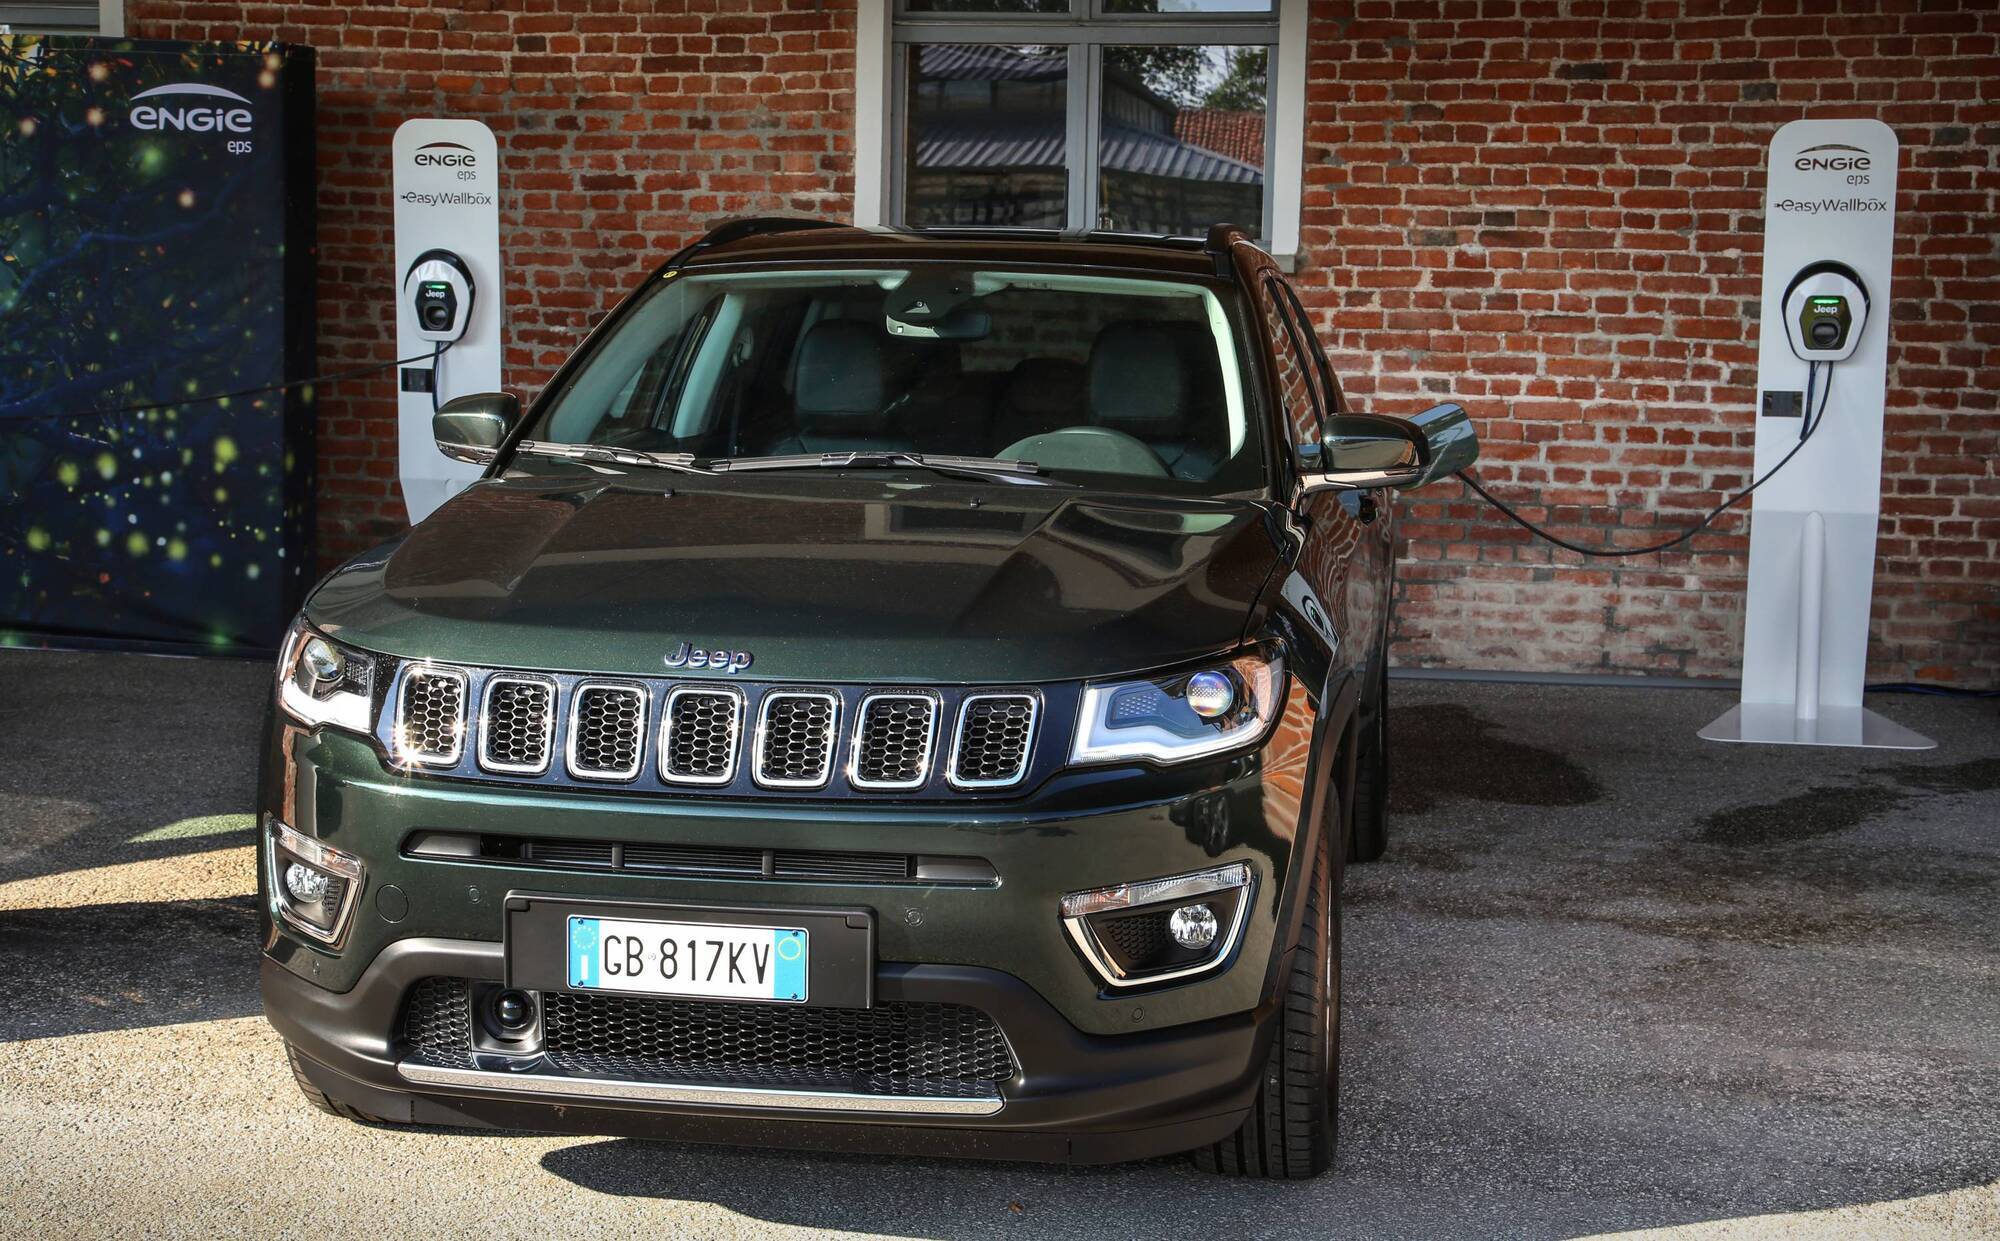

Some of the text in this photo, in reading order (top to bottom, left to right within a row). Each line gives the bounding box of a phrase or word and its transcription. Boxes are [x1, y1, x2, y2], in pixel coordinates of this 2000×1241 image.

[227, 140, 253, 154] eps
[456, 170, 477, 181] eps
[1846, 174, 1871, 186] eps
[425, 289, 446, 299] Jeep
[1813, 304, 1838, 314] Jeep
[664, 640, 754, 674] Jeep
[603, 934, 771, 985] GB 817KV
